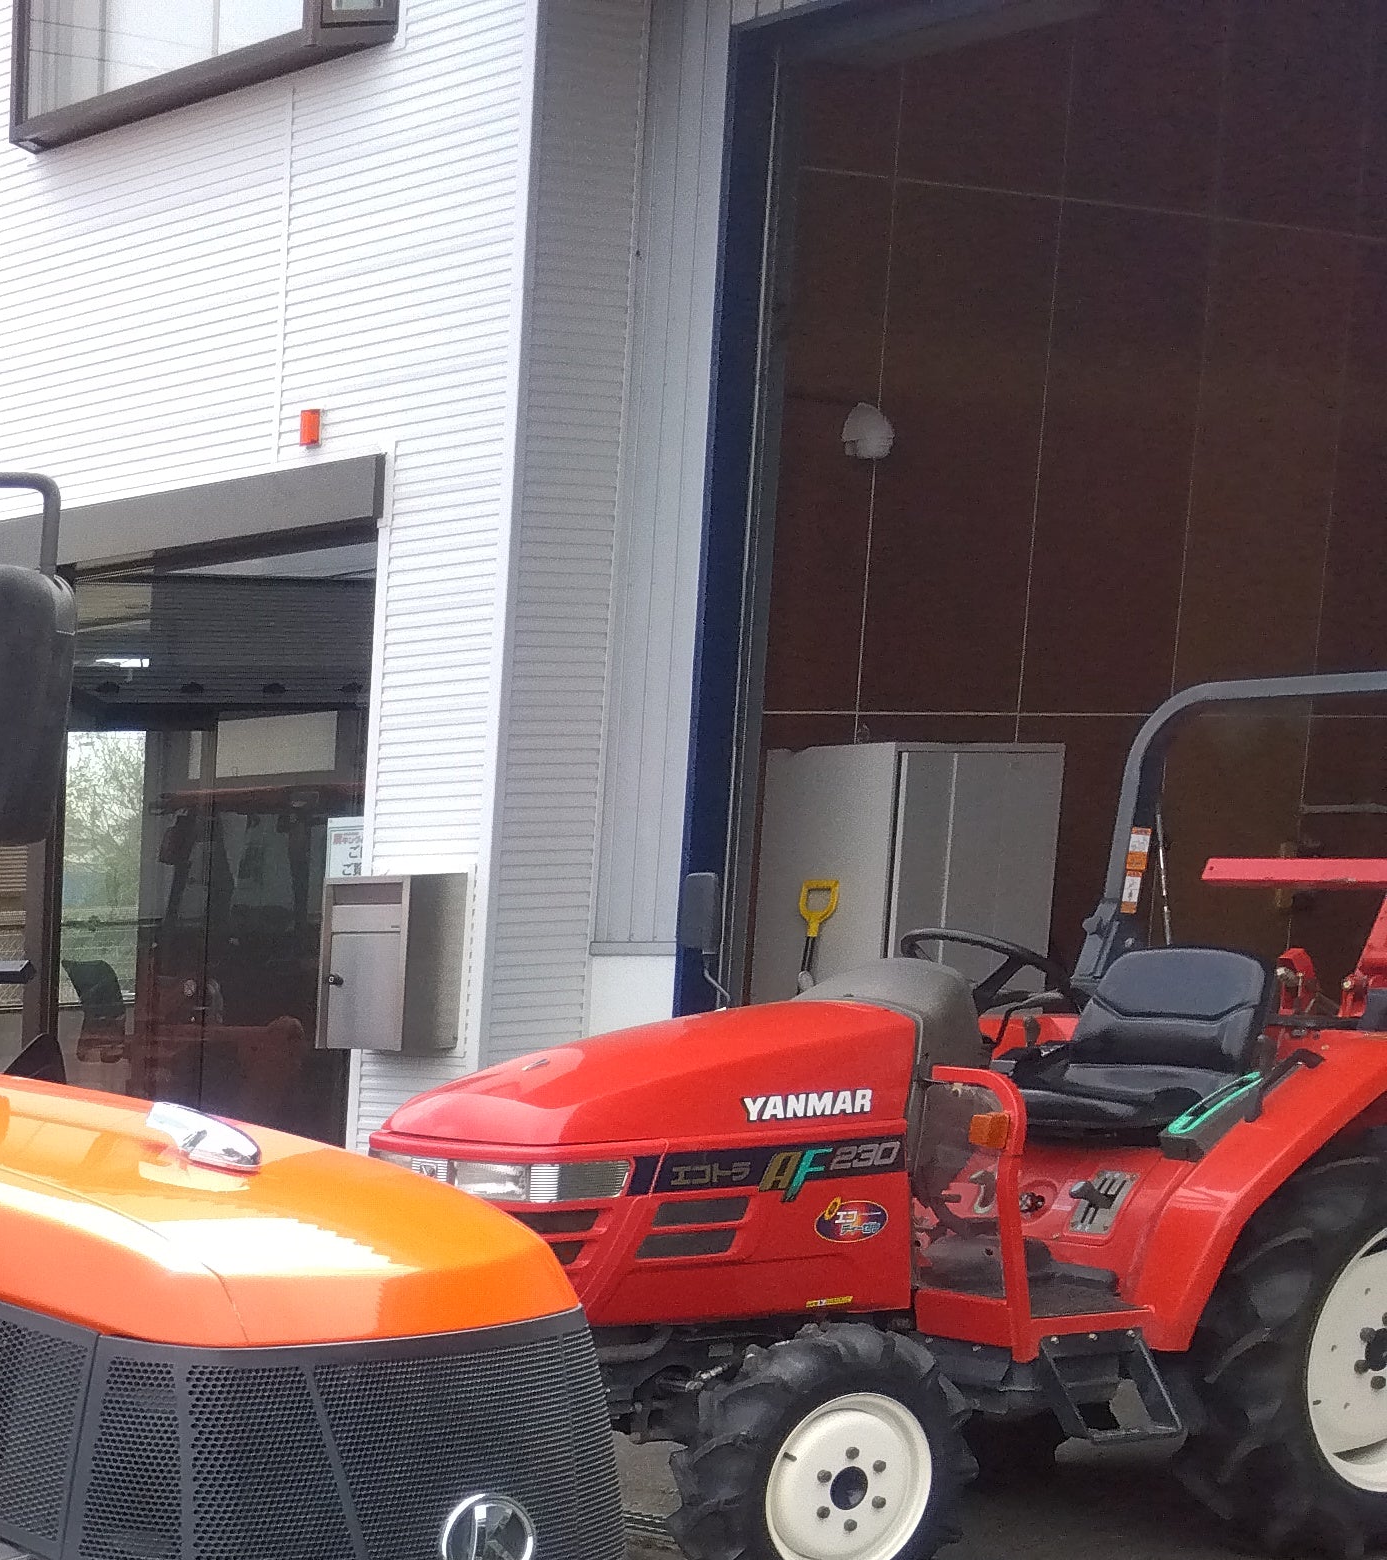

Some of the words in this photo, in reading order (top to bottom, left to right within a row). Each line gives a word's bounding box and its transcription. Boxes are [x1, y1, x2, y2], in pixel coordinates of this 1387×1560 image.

[744, 1089, 872, 1121] YANMAR
[671, 1161, 751, 1186] エコトラ
[758, 1148, 833, 1202] AF
[829, 1141, 901, 1171] 230
